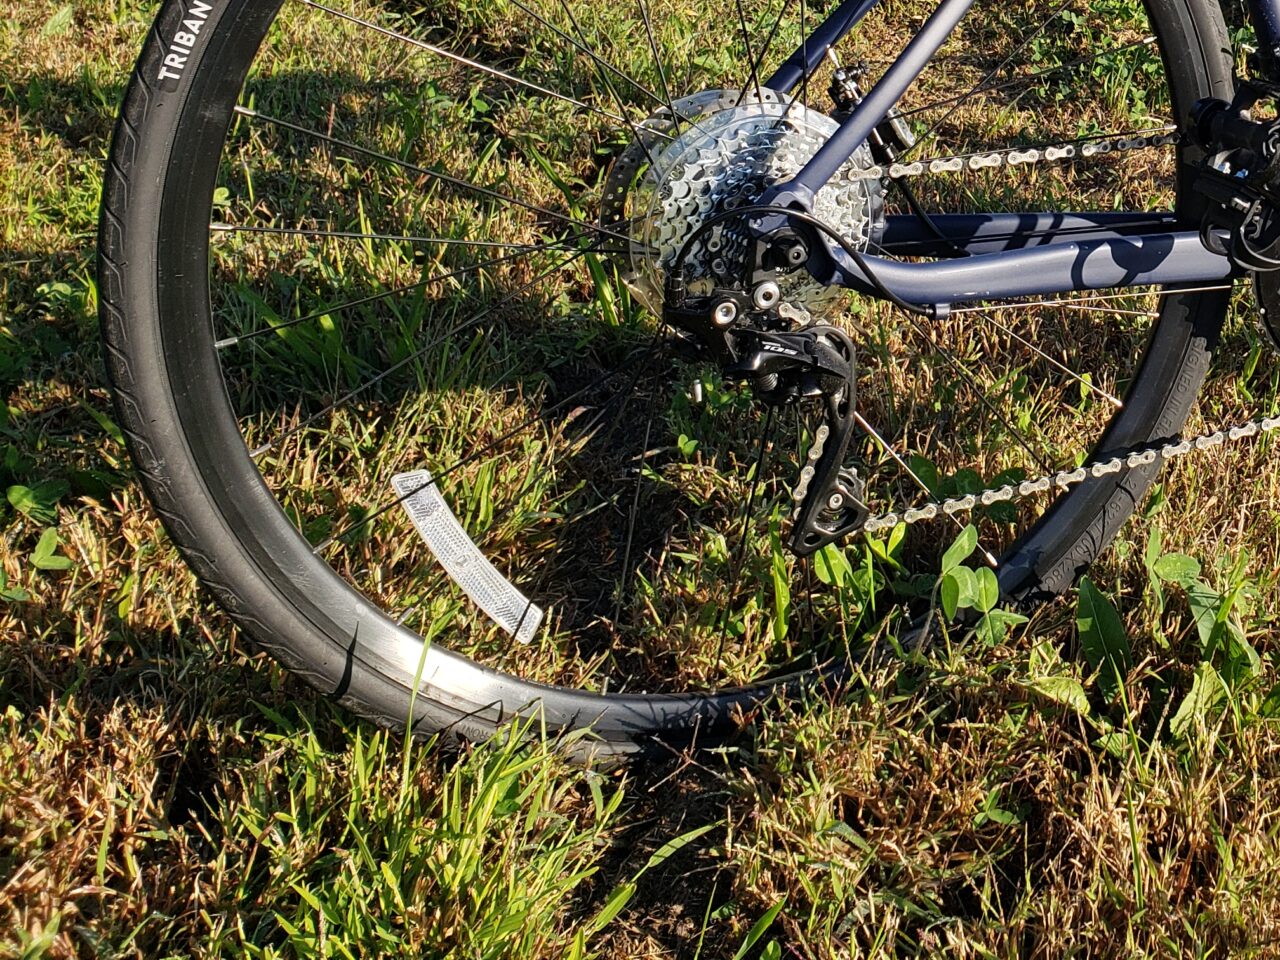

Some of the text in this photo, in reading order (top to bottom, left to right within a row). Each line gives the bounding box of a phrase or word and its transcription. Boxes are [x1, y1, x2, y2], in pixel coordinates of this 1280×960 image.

[158, 0, 213, 80] TRIBAN
[764, 345, 798, 356] 105
[1169, 341, 1207, 415] SIGNED IN
